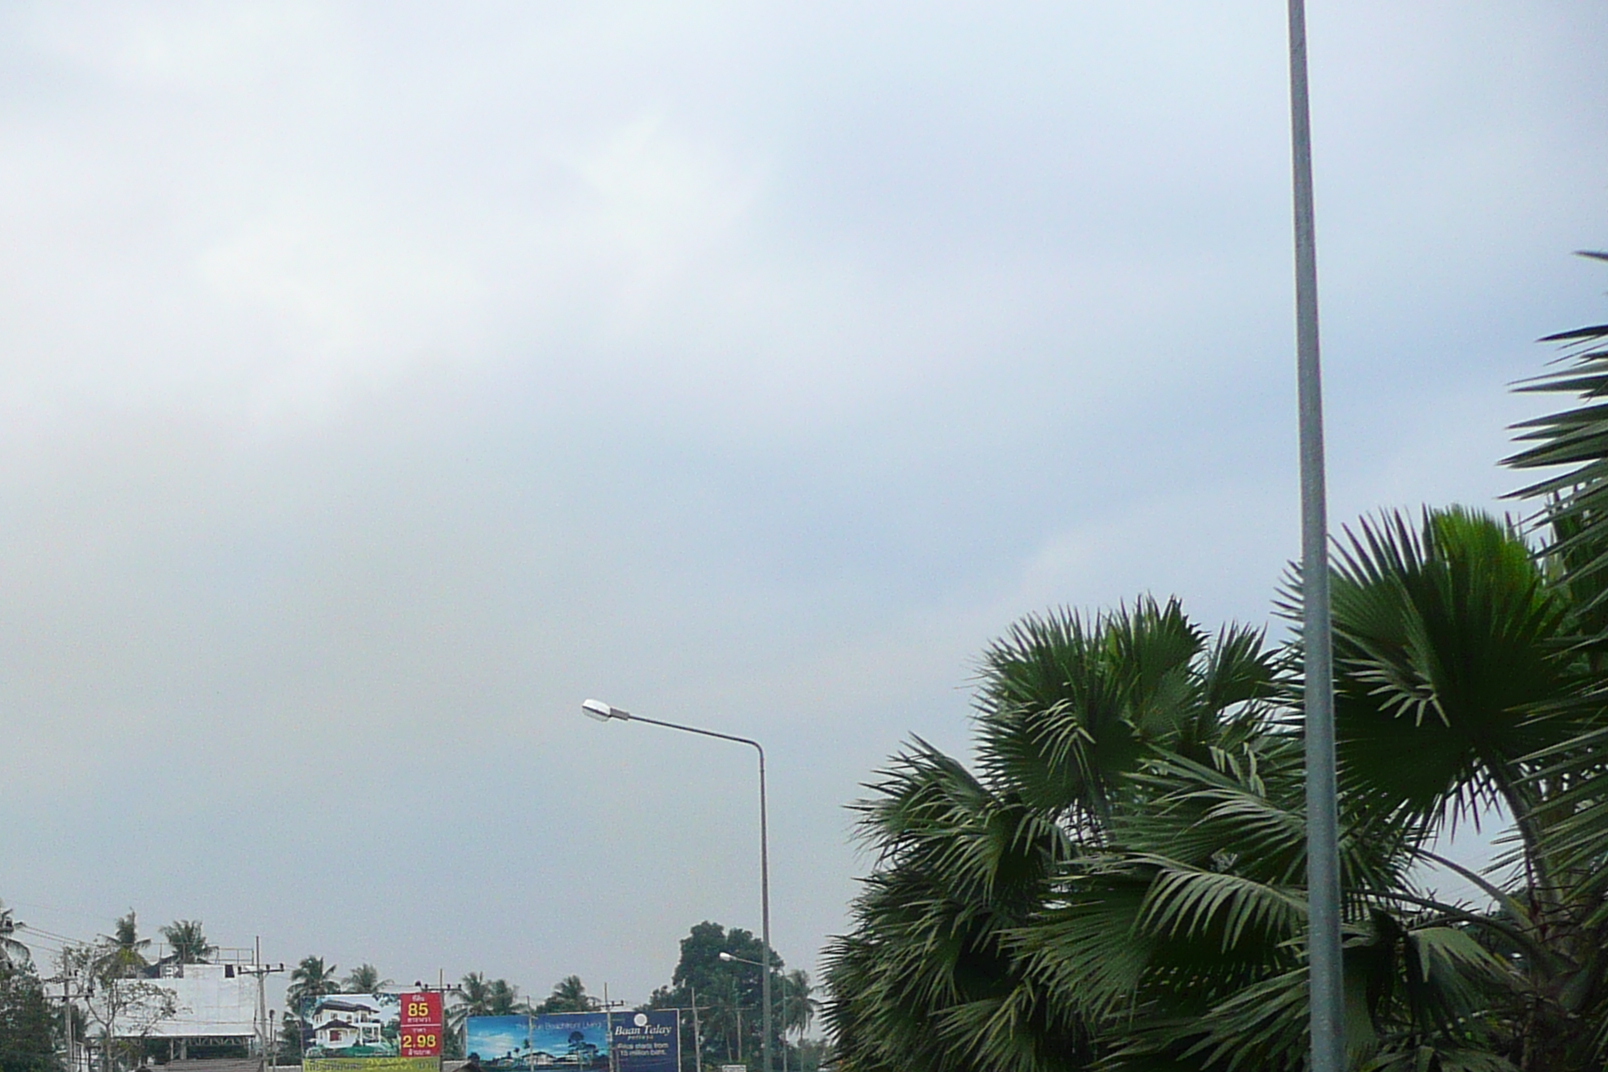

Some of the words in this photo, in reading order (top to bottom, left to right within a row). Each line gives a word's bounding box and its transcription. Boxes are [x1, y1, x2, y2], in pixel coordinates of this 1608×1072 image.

[408, 1003, 429, 1017] 85
[614, 1025, 641, 1036] Baan
[643, 1024, 672, 1037] Talay
[403, 1034, 437, 1048] 2.98
